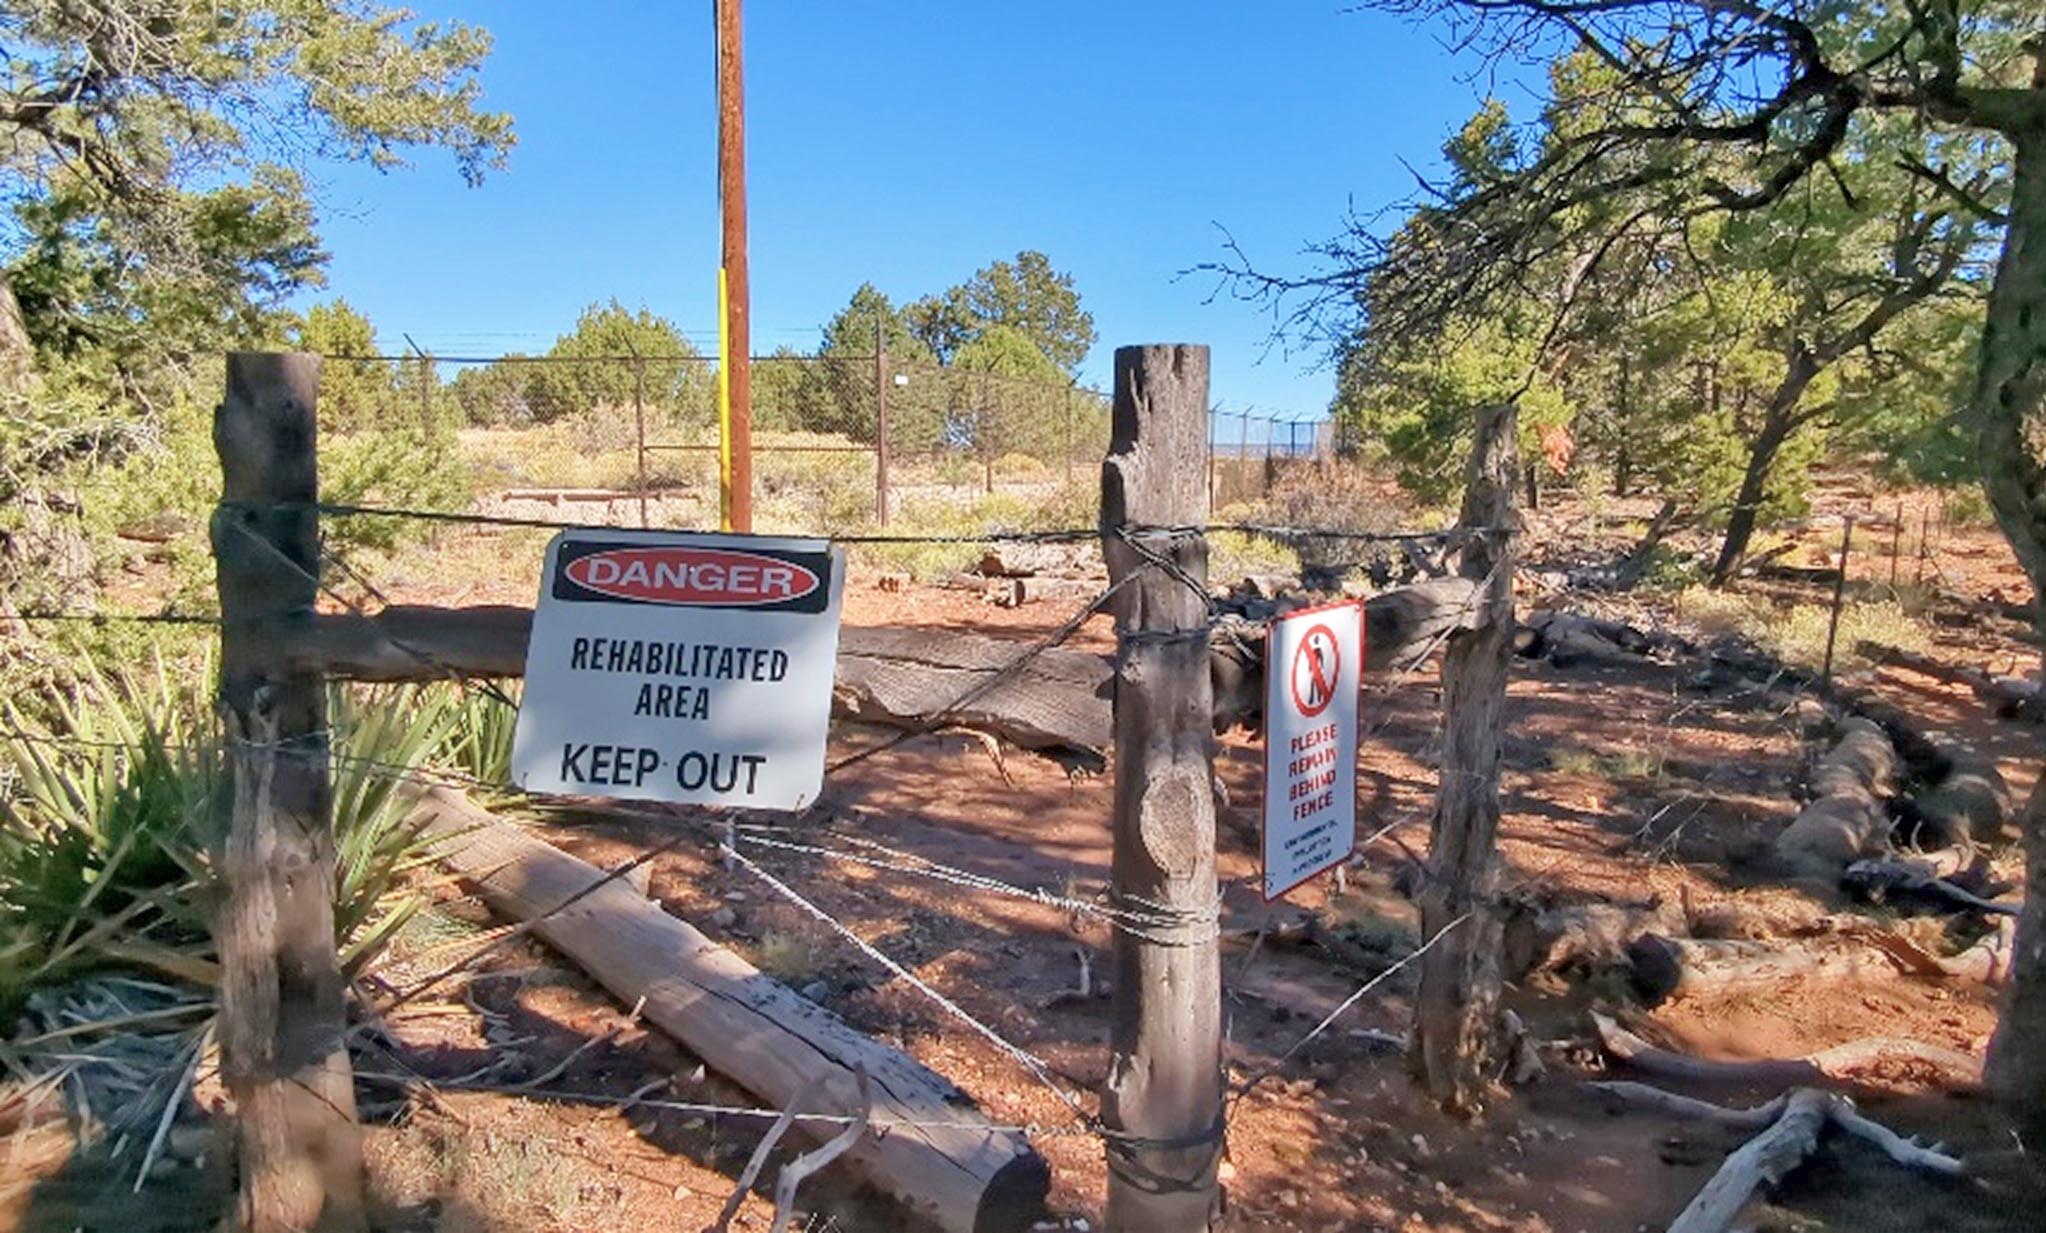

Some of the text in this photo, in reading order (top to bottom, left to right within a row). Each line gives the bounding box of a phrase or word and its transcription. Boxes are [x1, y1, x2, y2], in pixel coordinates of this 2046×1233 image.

[587, 557, 793, 595] DANGER
[571, 638, 789, 682] REHABILITATED
[634, 683, 710, 720] AREA
[1291, 724, 1337, 754] PLEASE
[560, 743, 766, 794] KEEP OUT
[1289, 747, 1337, 777] REMAIN
[1289, 769, 1336, 801] BEHIND
[1293, 791, 1334, 822] FENCE
